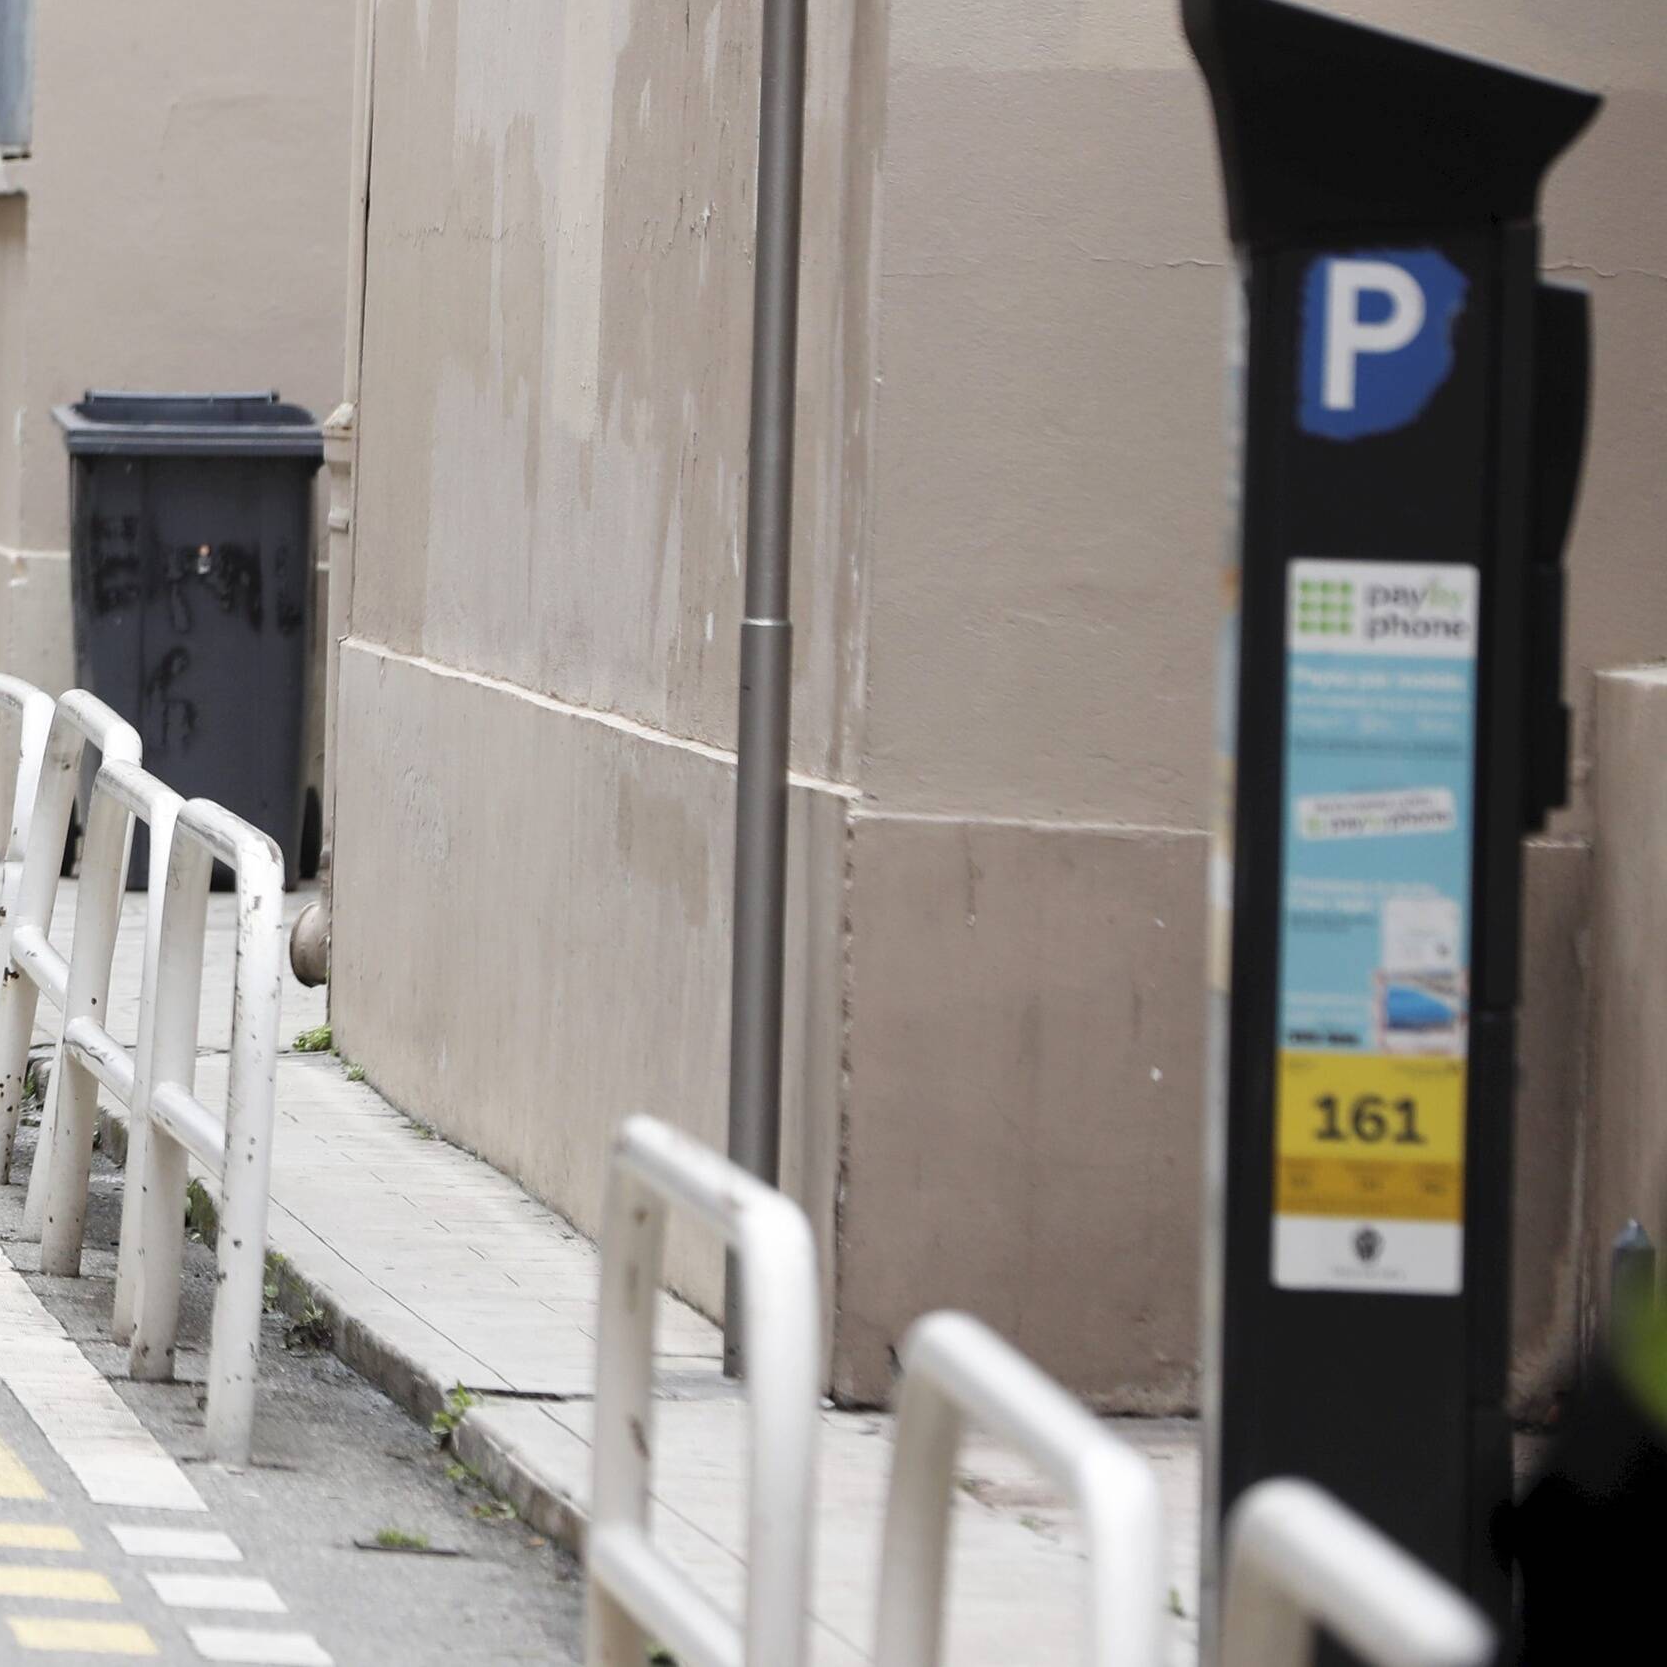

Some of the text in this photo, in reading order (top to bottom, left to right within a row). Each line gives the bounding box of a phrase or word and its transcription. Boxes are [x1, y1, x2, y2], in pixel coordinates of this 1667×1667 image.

[1323, 257, 1427, 411] P
[1368, 611, 1470, 642] phone
[1313, 1095, 1427, 1145] 161
